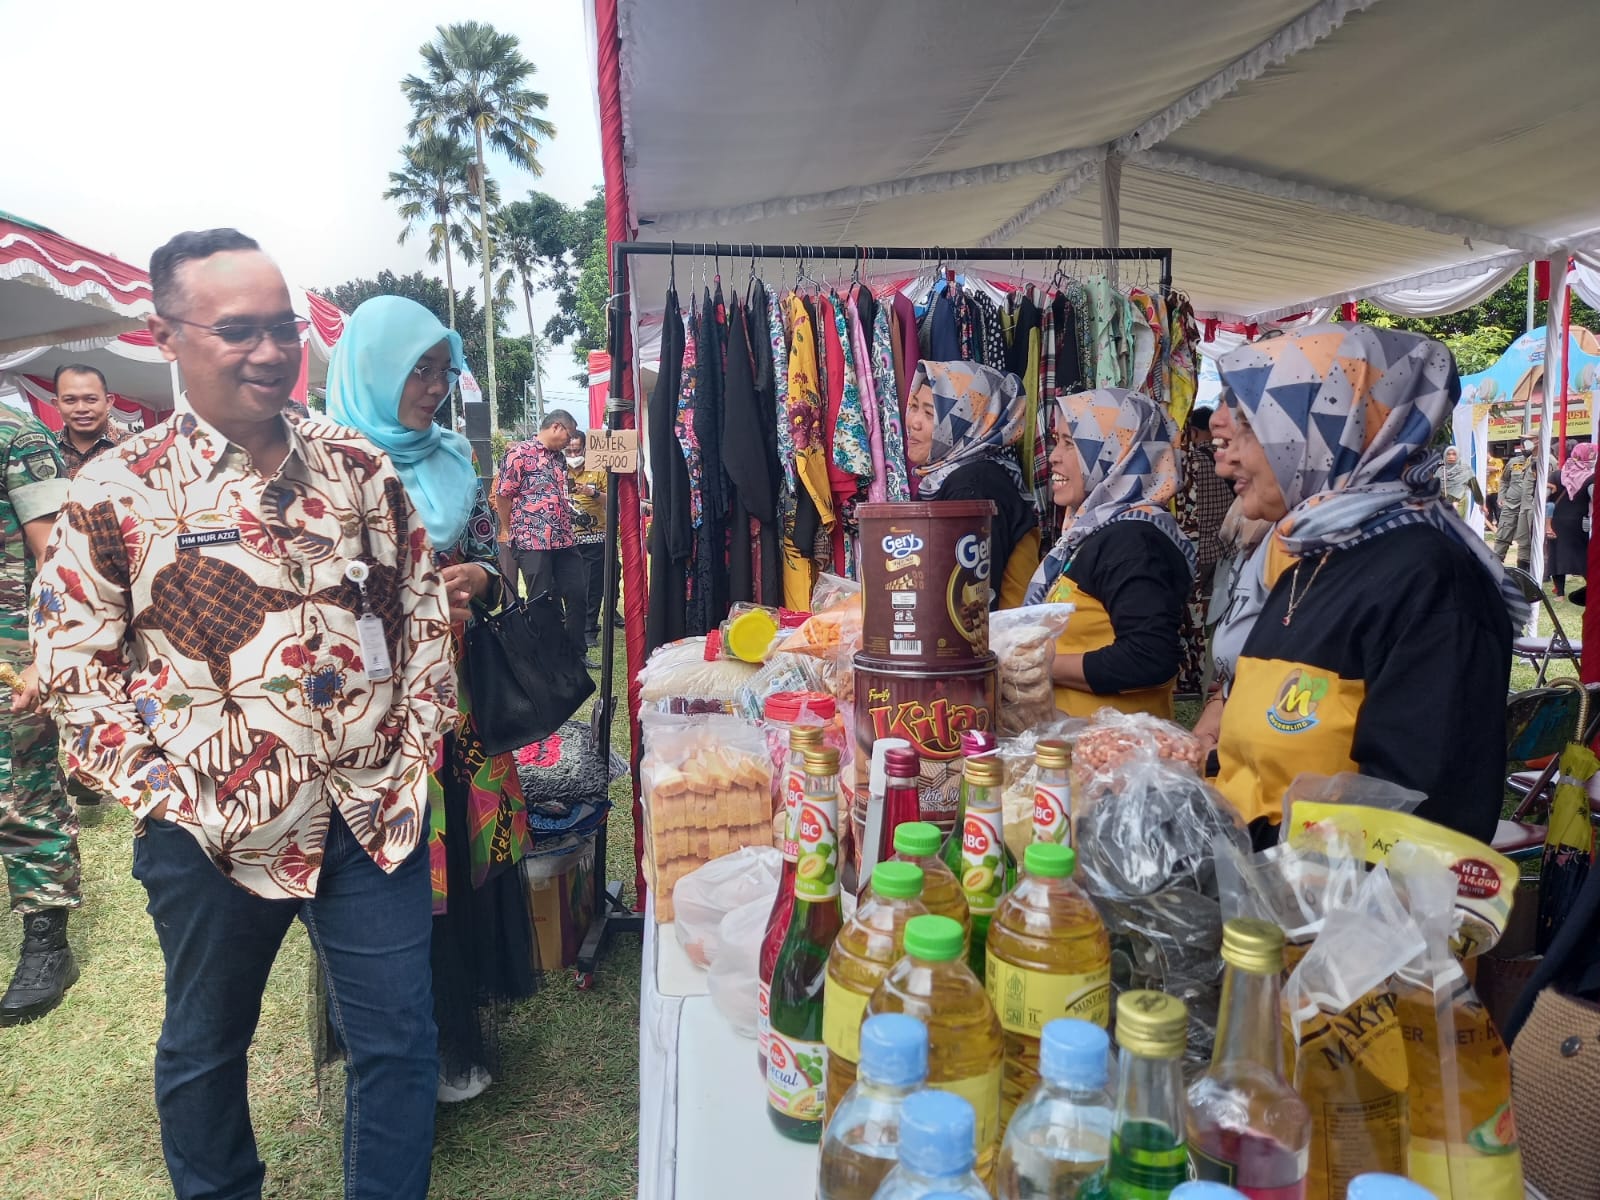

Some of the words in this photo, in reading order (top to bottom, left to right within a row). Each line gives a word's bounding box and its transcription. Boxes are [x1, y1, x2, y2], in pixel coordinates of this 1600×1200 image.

[590, 434, 626, 450] DASTER
[592, 454, 628, 469] 35000
[181, 536, 195, 545] HM
[197, 533, 216, 543] NUR
[217, 531, 237, 541] AZIZ
[882, 533, 923, 558] Gery
[955, 534, 990, 579] Ger
[1276, 684, 1312, 717] M
[787, 790, 804, 801] BC
[1034, 806, 1053, 822] BC
[1462, 864, 1488, 876] HET
